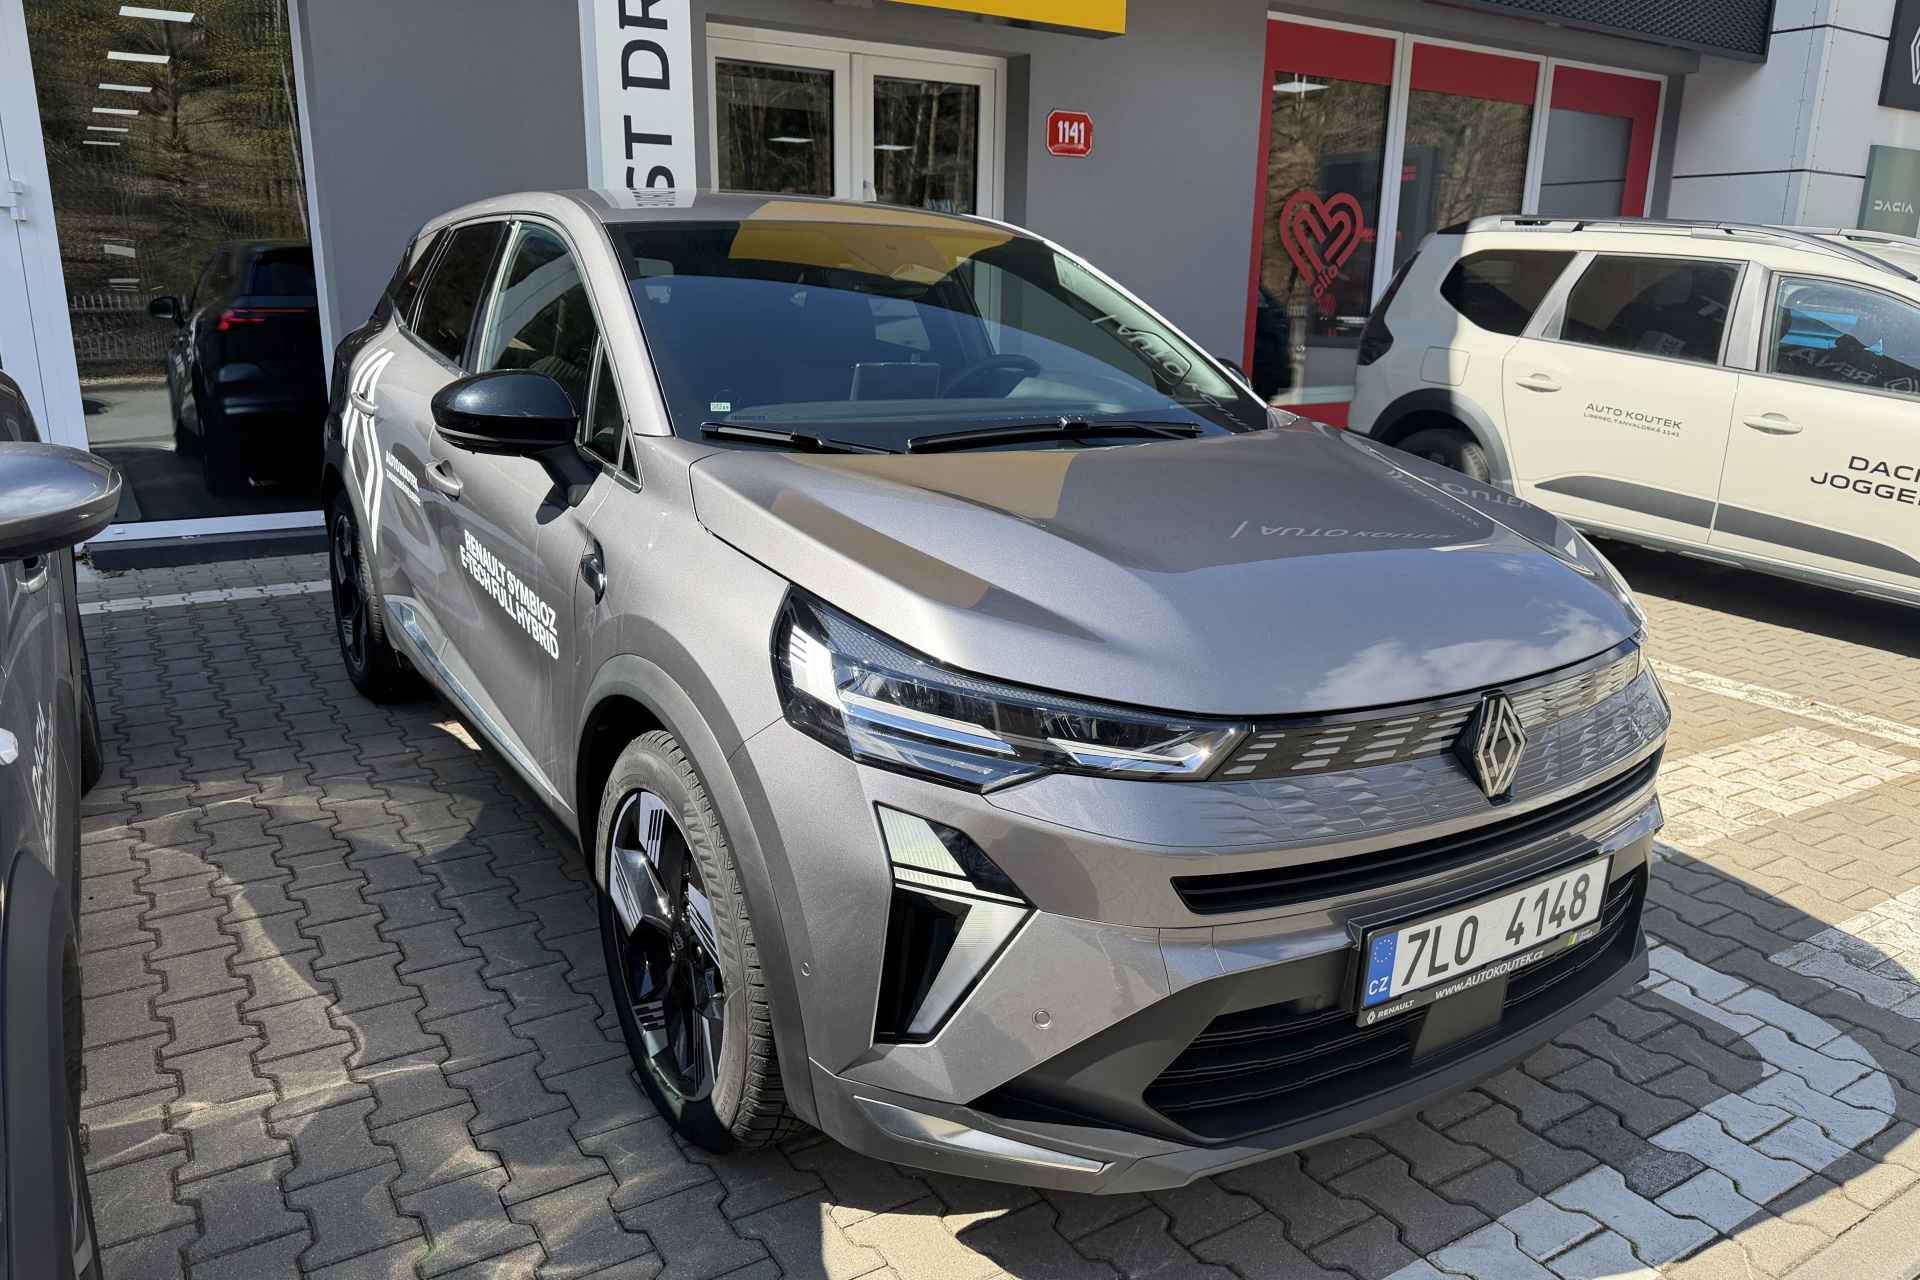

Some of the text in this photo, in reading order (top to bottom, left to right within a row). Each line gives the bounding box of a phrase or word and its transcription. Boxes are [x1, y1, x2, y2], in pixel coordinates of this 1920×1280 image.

[1057, 120, 1085, 145] 1141
[1873, 199, 1914, 214] DACIA
[1313, 263, 1339, 298] clio
[1585, 403, 1683, 430] AUTO KOUTEK
[1661, 429, 1680, 438] 1141
[1809, 472, 1920, 506] JOGGE
[464, 529, 558, 636] RENAULT SYMBIOZ
[459, 544, 559, 660] E-TECH FULL HYBRID
[1505, 873, 1591, 946] 4148
[1368, 976, 1389, 996] CZ
[1377, 999, 1415, 1019] RENAULT
